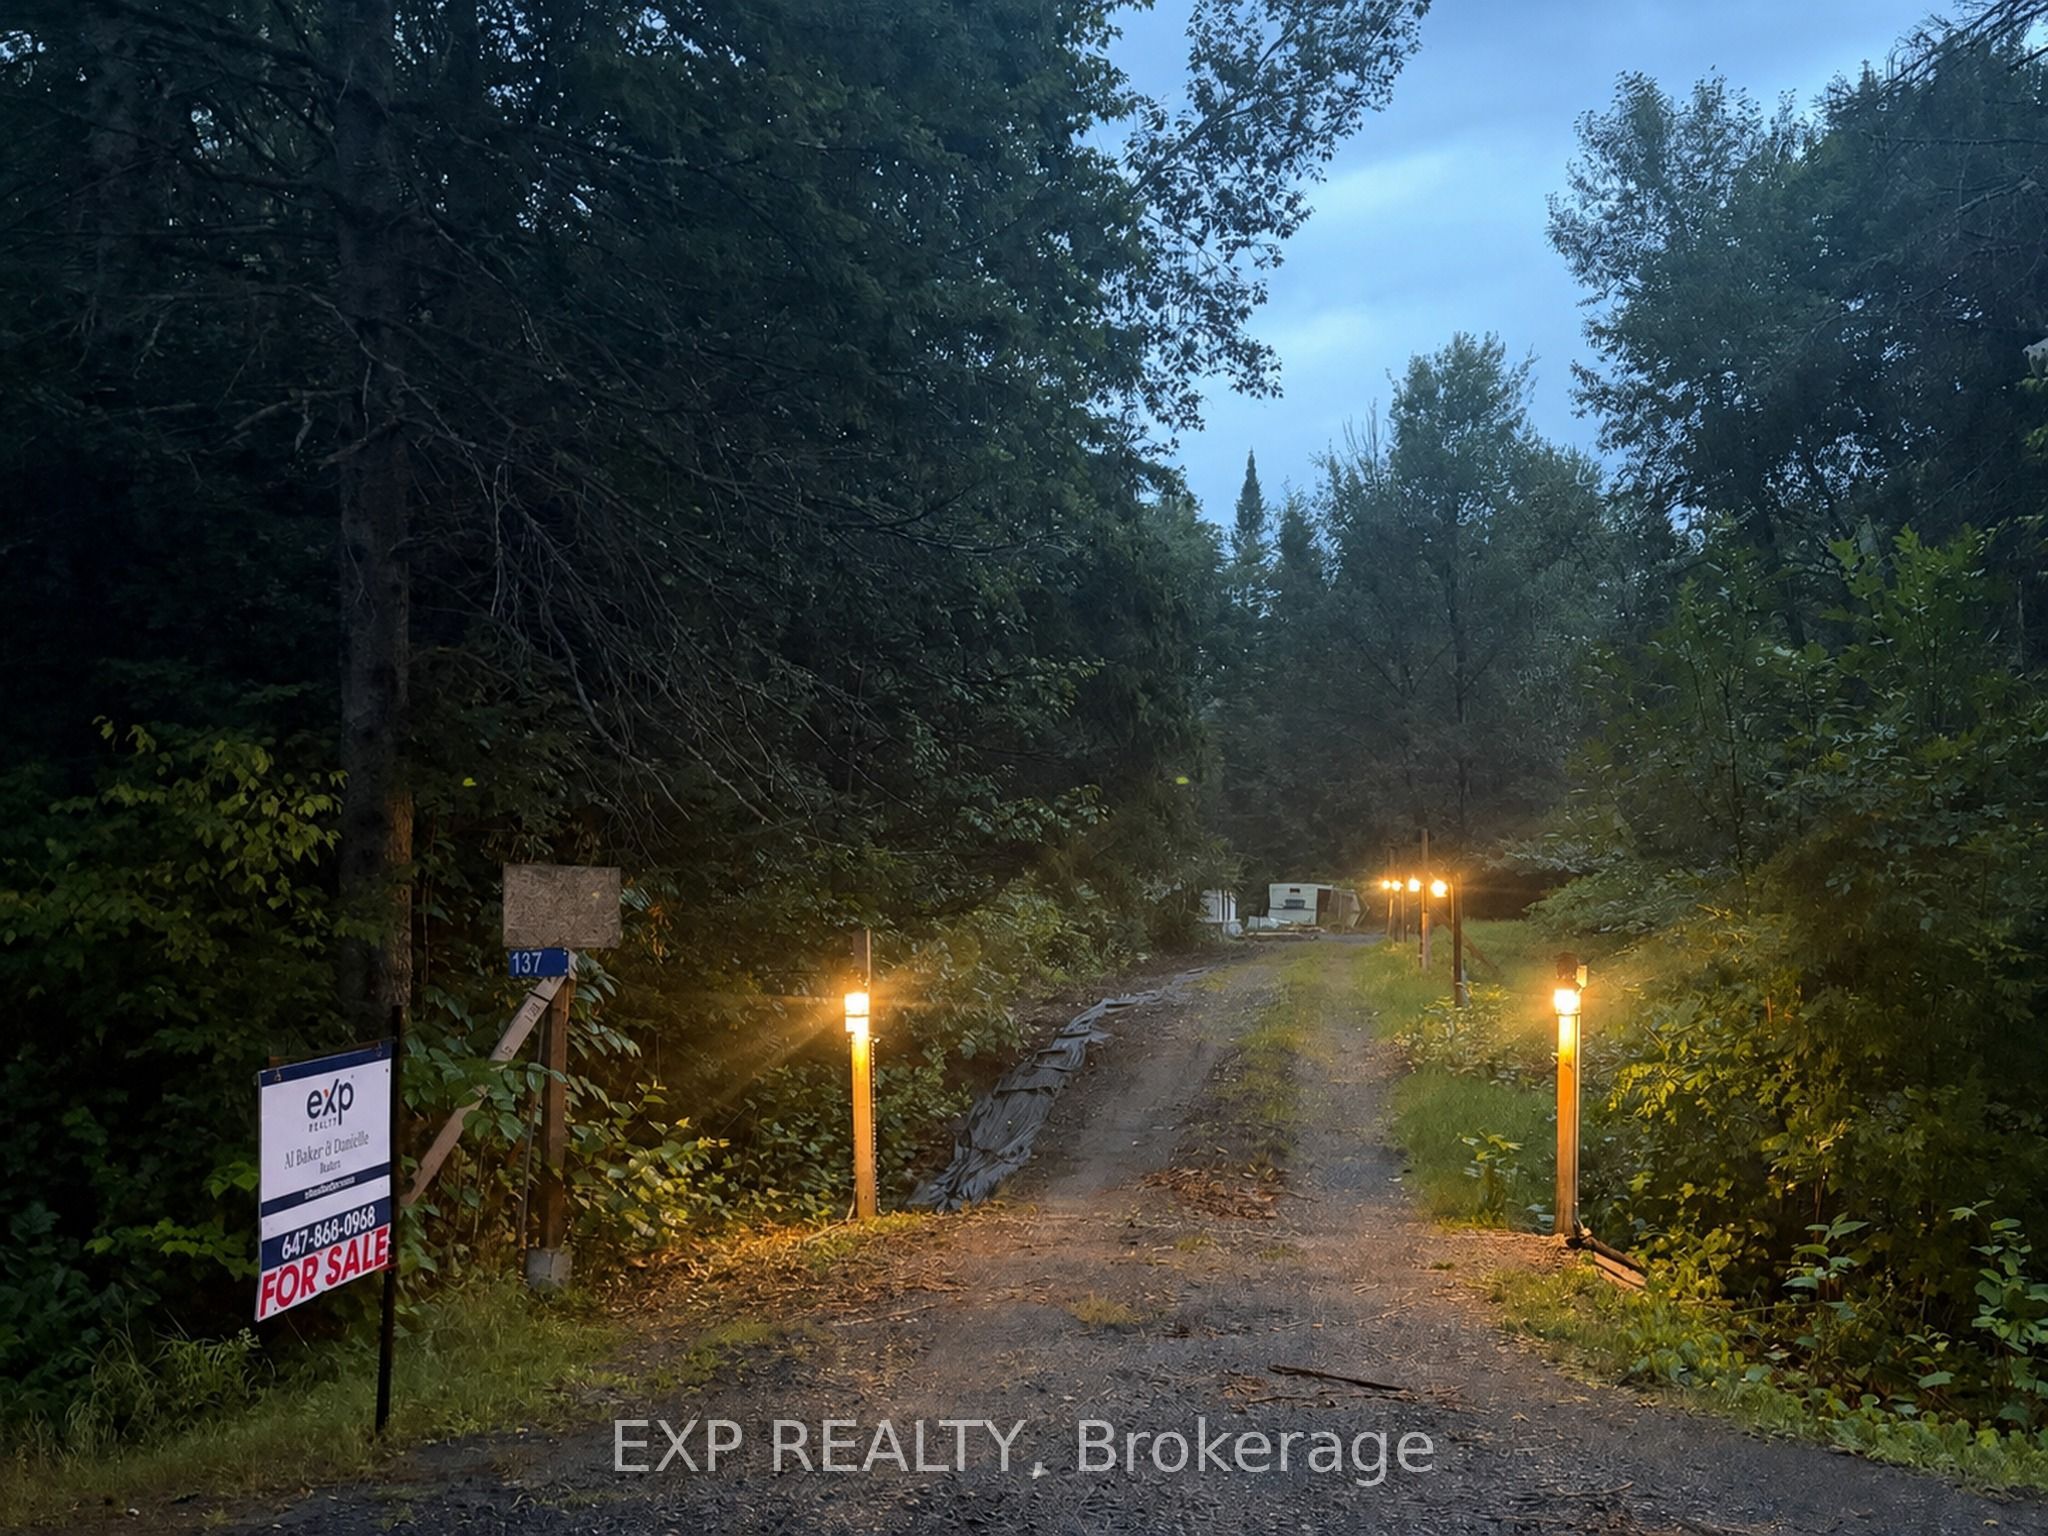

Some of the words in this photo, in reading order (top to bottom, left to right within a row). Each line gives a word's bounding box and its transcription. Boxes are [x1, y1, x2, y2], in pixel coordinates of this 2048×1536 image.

[512, 952, 542, 974] 137
[296, 1145, 323, 1166] Baker
[334, 1130, 369, 1154] Danielle
[282, 1205, 376, 1260] 647-868-0968
[259, 1255, 319, 1318] FOR
[325, 1226, 389, 1286] SALE
